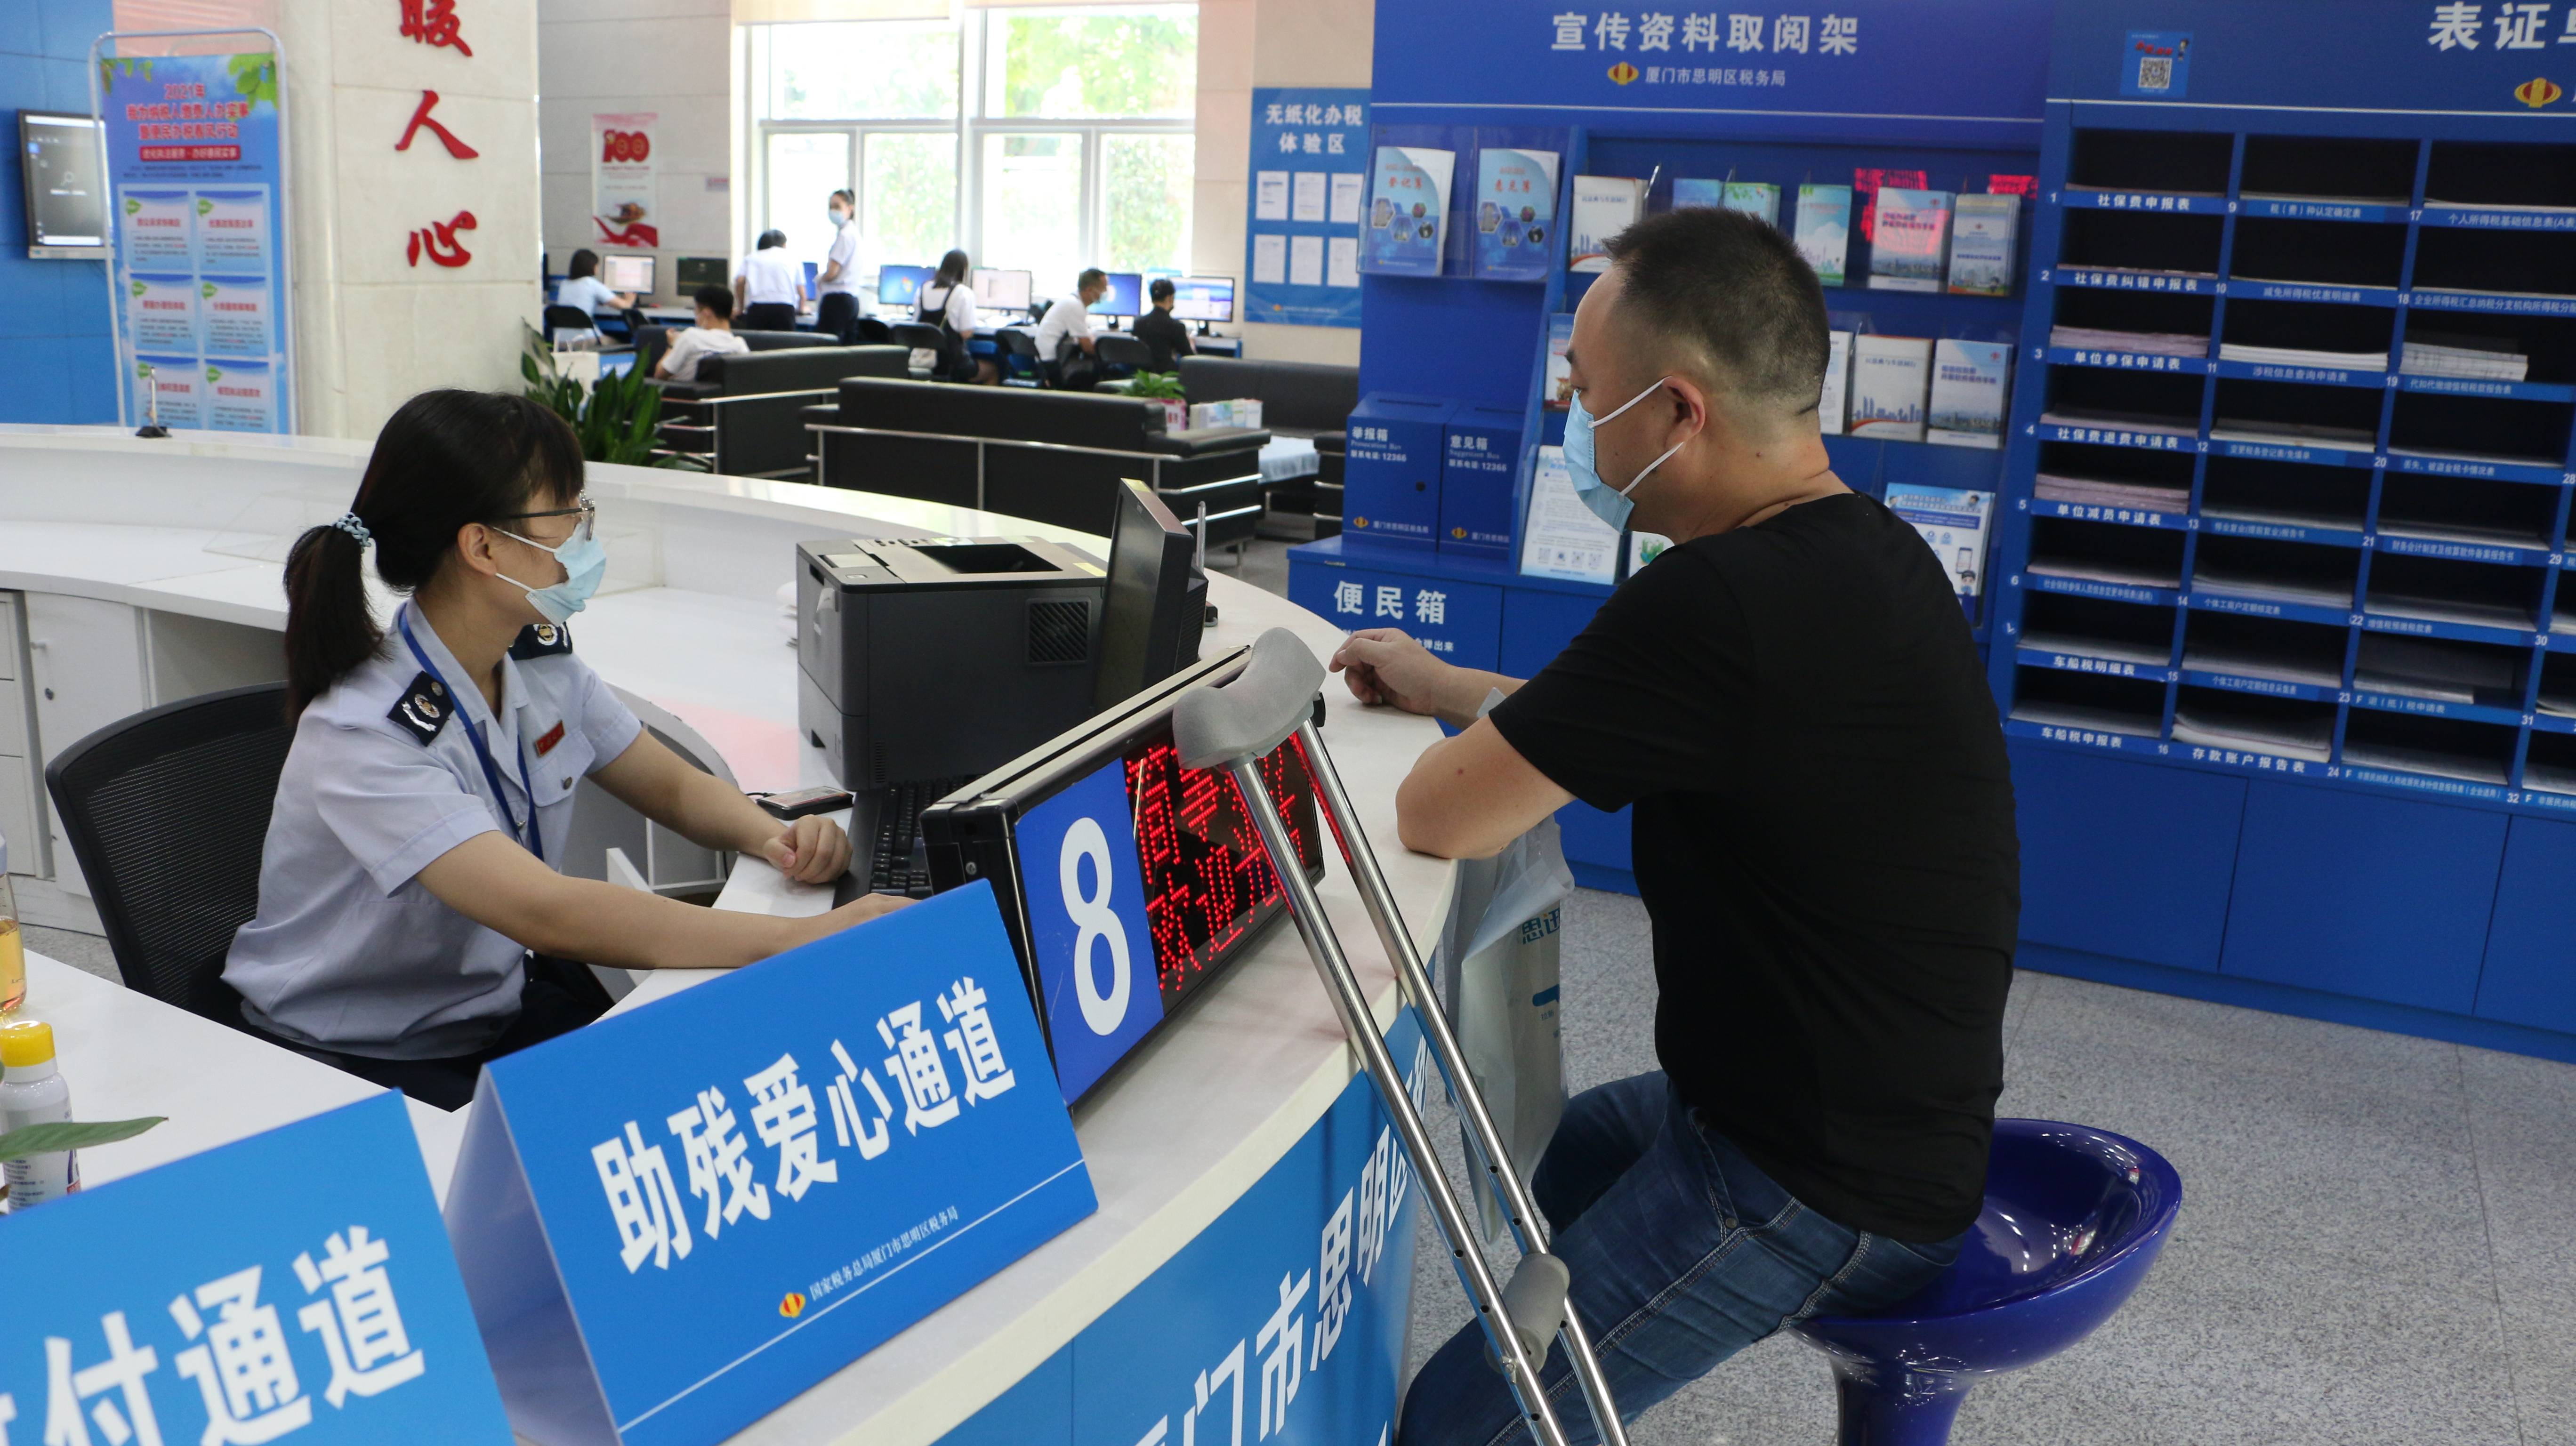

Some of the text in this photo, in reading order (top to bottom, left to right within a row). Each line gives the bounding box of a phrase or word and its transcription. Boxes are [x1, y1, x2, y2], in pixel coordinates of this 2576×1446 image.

[1551, 12, 1858, 56] 宣传资料取阅架
[1645, 64, 1786, 87] 厦门市思明区税务局
[1266, 104, 1363, 126] 无纸化办税
[1280, 132, 1345, 154] 体验区
[2051, 193, 2057, 202] 1
[2098, 194, 2190, 211] 社保费申报表
[2228, 201, 2237, 213] 9
[2410, 210, 2422, 221] 17
[2041, 271, 2049, 281] 2
[2075, 273, 2197, 291] 社保费纠错申报表
[2216, 283, 2227, 294] 10
[2398, 294, 2409, 305] 18
[2035, 349, 2042, 359] 3
[2075, 351, 2180, 371] 单位参保申请表
[2208, 363, 2217, 373] 11
[2387, 376, 2398, 387] 19
[1352, 426, 1388, 442] 举报箱
[2026, 425, 2035, 435] 4
[1450, 435, 1488, 450] 意见箱
[2058, 427, 2178, 449] 社保费退费申请表
[2198, 442, 2208, 452] 12
[1383, 452, 1407, 462] 12366
[2374, 457, 2387, 468] 20
[2563, 473, 2576, 484] 28
[2019, 500, 2026, 510] 5
[2058, 504, 2161, 526] 单位减员申请表
[2189, 519, 2199, 530] 13
[2363, 536, 2375, 546] 21
[2548, 554, 2562, 565] 29
[2011, 576, 2019, 586] 6
[1334, 580, 1447, 625] 便民箱
[2178, 596, 2188, 607] 14
[2351, 616, 2363, 626] 22
[2535, 634, 2548, 646] 30
[2053, 655, 2134, 676] 车船税明细表
[2168, 671, 2178, 682] 15
[2339, 692, 2351, 703] 23
[2356, 695, 2363, 704] F
[2522, 714, 2534, 725] 31
[2042, 727, 2122, 748] 车船税申报表
[2158, 745, 2168, 755] 16
[2193, 747, 2305, 773] 存款账户报告表
[2327, 767, 2339, 777] 24
[2345, 769, 2352, 778] F
[2507, 792, 2520, 803] 32
[1060, 817, 1131, 1036] 8
[590, 976, 1016, 1274] 助残爱心通道
[809, 1205, 958, 1301] 国家税务总局厦门市思明区税务局
[0, 1225, 425, 1446] 付通道
